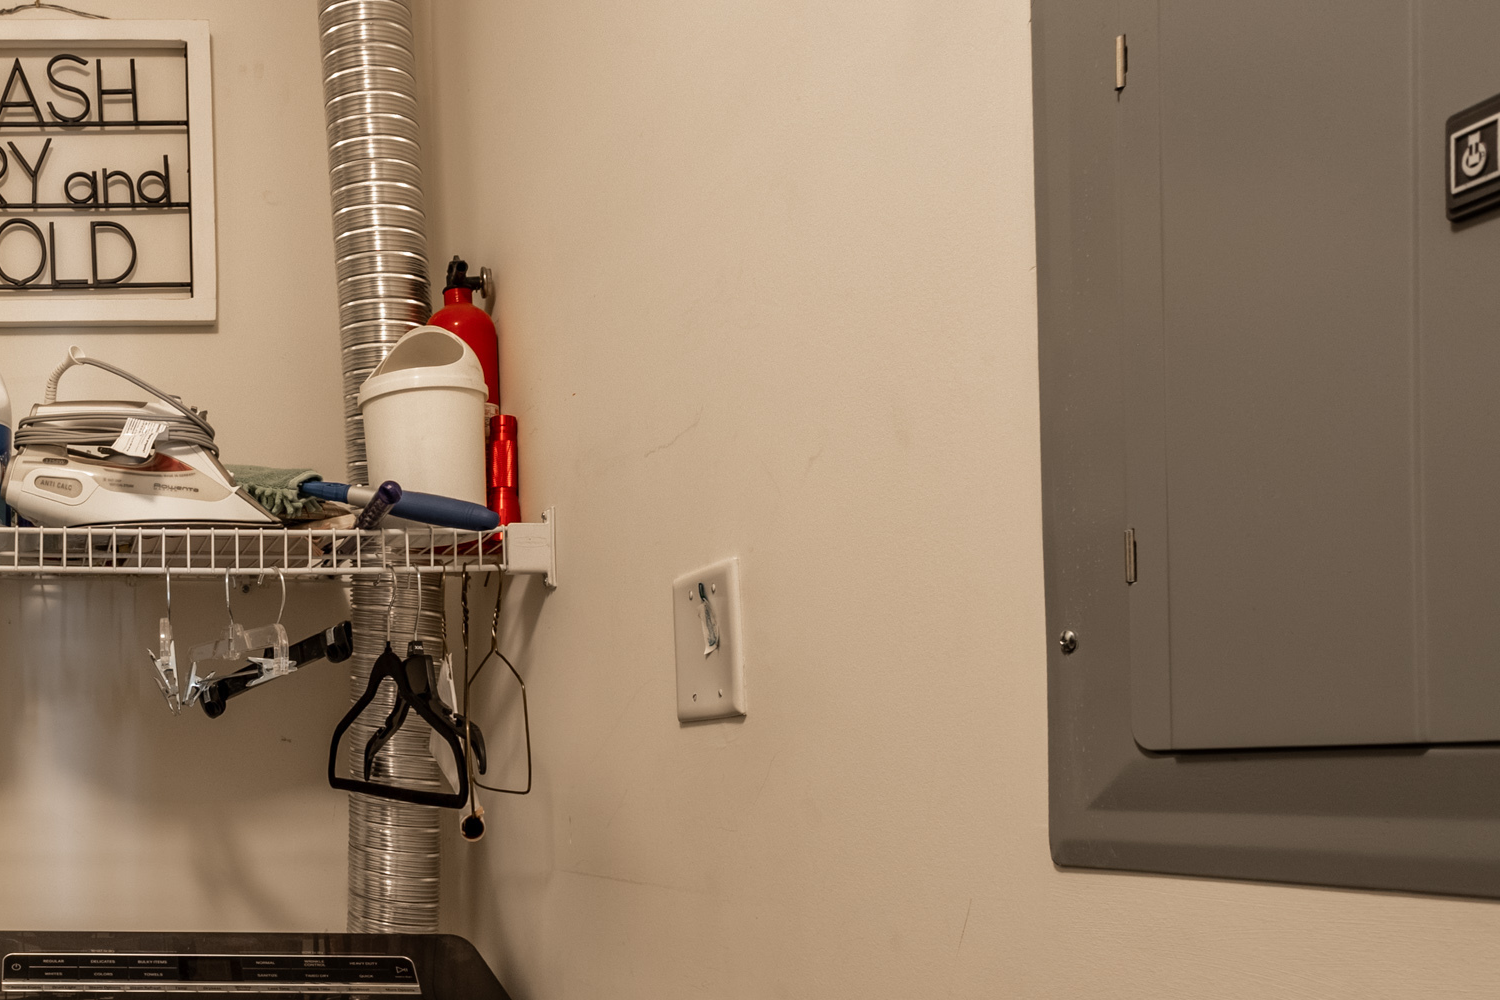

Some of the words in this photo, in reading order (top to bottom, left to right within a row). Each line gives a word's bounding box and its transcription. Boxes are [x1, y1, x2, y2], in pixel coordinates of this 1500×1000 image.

[64, 154, 171, 205] and
[40, 479, 56, 487] ANTI
[56, 482, 73, 491] CALC
[153, 482, 200, 493] Rowenta
